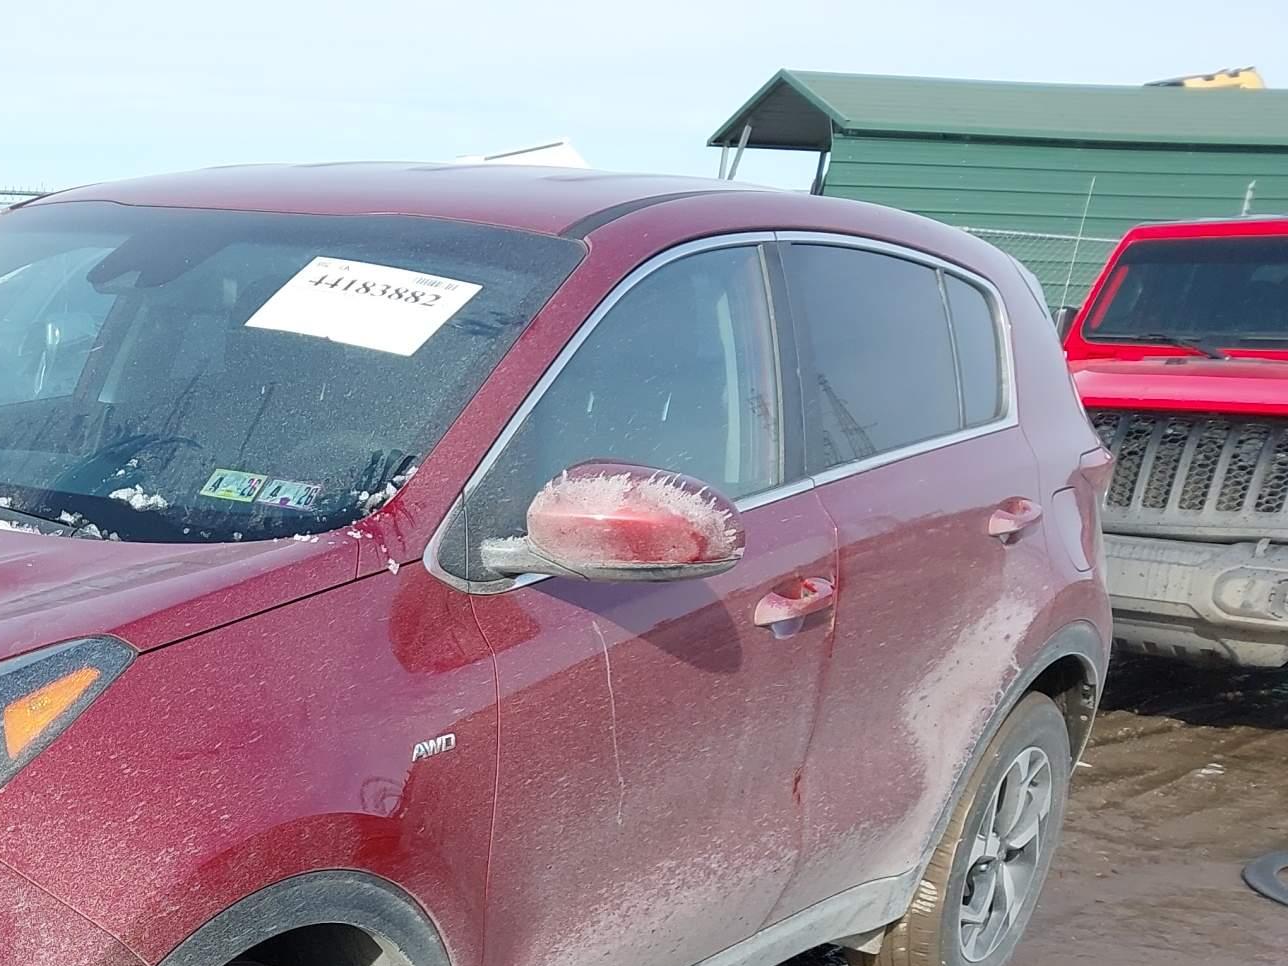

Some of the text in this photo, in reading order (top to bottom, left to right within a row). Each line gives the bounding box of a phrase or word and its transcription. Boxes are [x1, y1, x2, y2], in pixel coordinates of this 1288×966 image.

[309, 273, 441, 307] 44183882
[269, 485, 318, 505] 4 26
[411, 732, 456, 762] AWD
